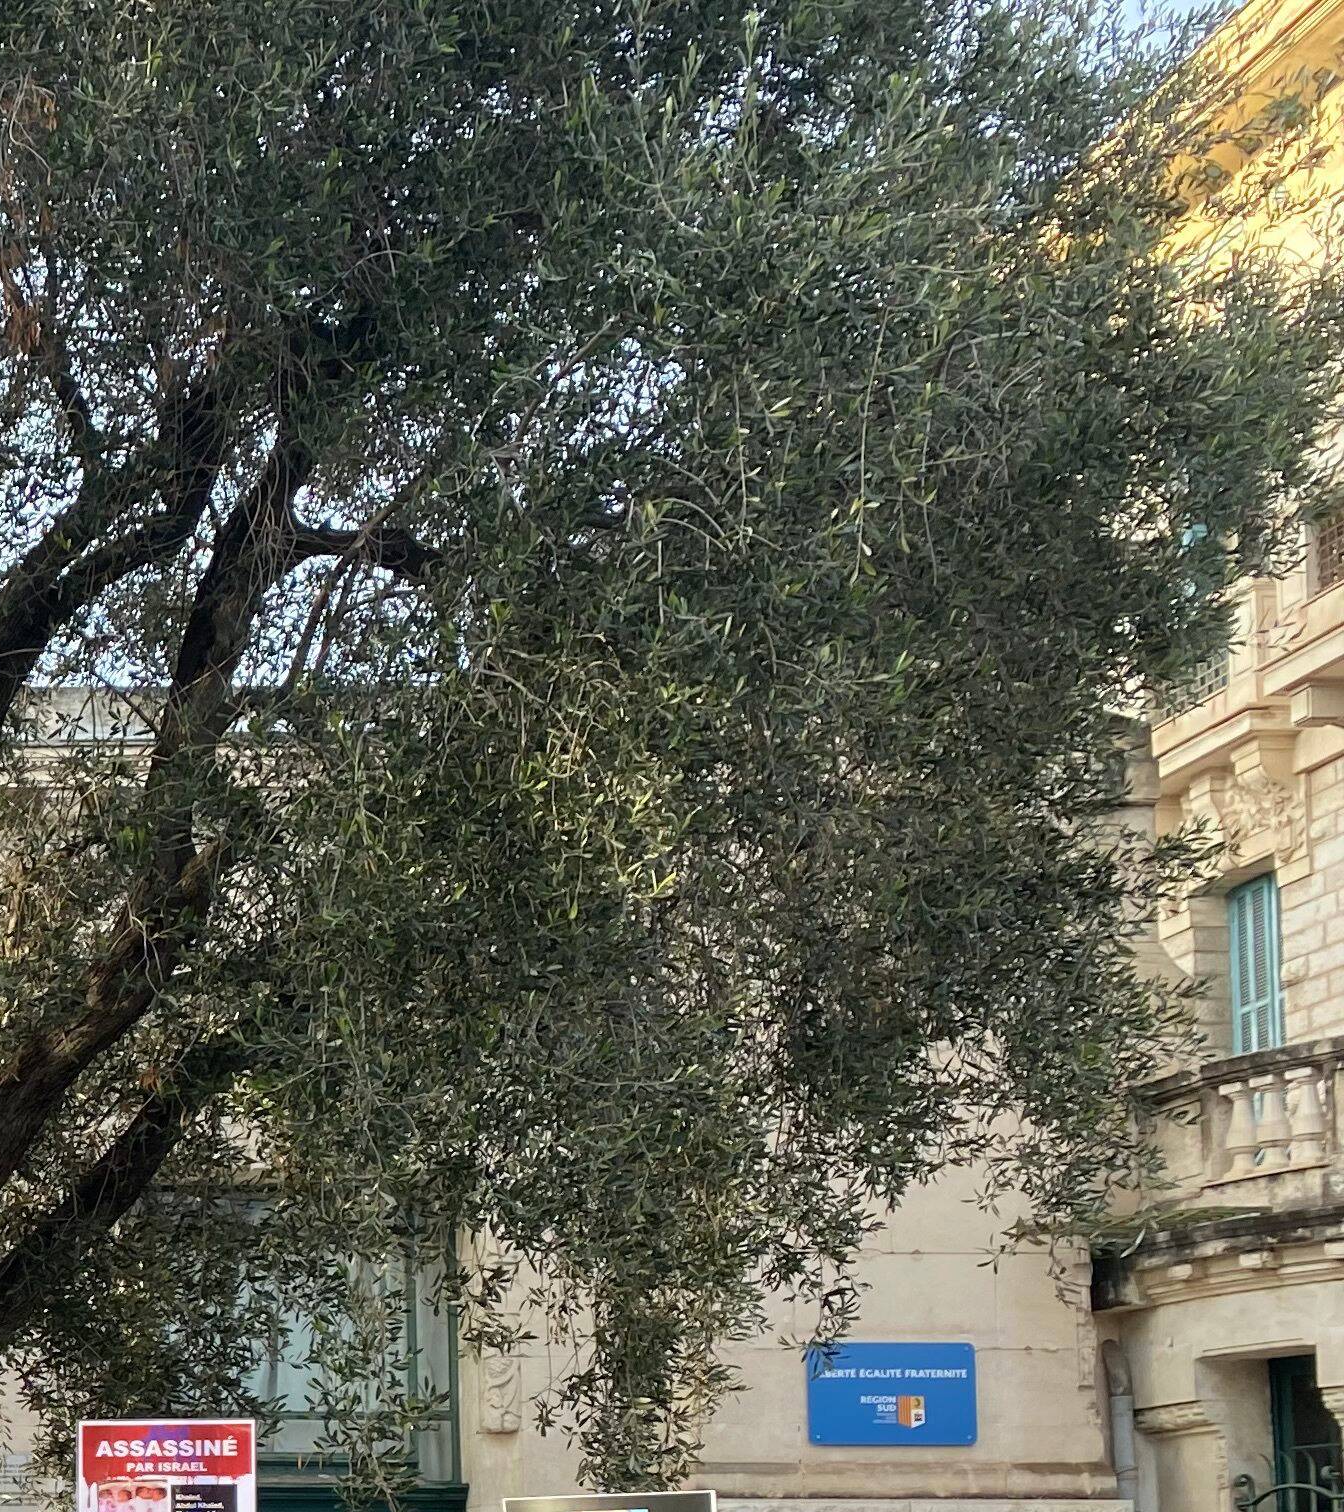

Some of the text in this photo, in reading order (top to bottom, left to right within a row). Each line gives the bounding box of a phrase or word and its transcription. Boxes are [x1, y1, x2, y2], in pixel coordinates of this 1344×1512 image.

[877, 1404, 896, 1412] SUD
[95, 1436, 238, 1457] ASSASSINÉ
[126, 1462, 207, 1472] PAR ISRAEL
